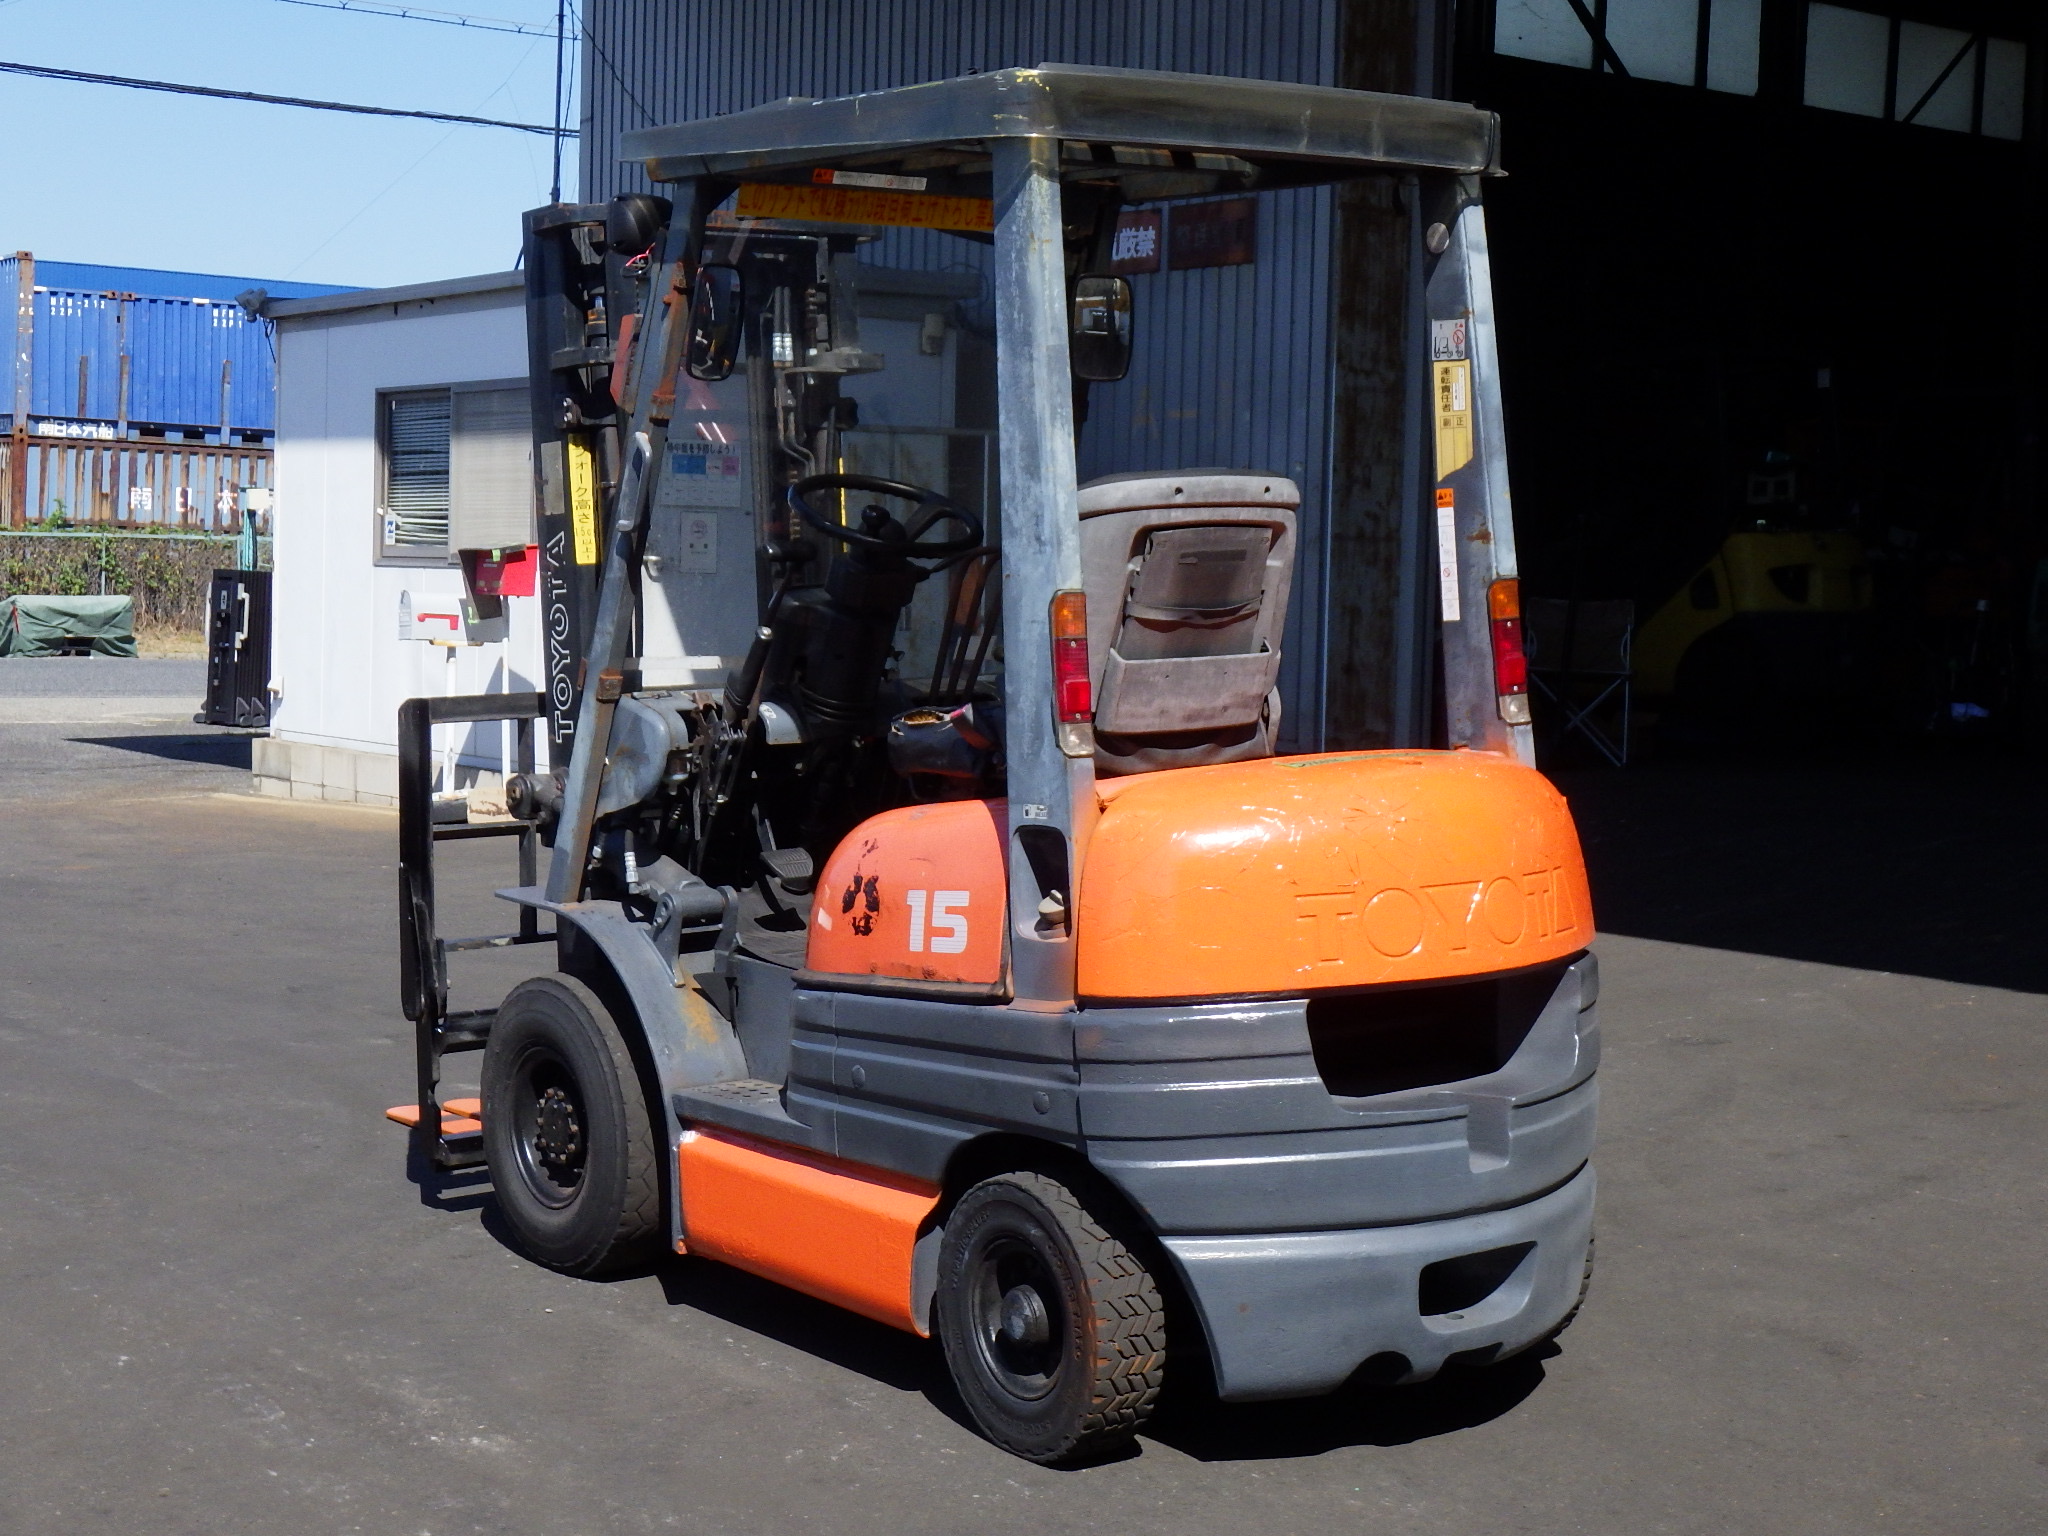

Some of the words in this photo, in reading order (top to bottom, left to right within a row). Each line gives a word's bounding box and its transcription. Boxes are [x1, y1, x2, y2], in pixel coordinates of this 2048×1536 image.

[1112, 225, 1156, 260] 厳禁
[50, 307, 81, 317] 22P1
[213, 318, 242, 328] 22P1
[38, 418, 113, 439] 南日本汽船
[546, 530, 574, 744] TOYOTA
[906, 889, 970, 954] 15
[1294, 865, 1578, 966] TOYOTA
